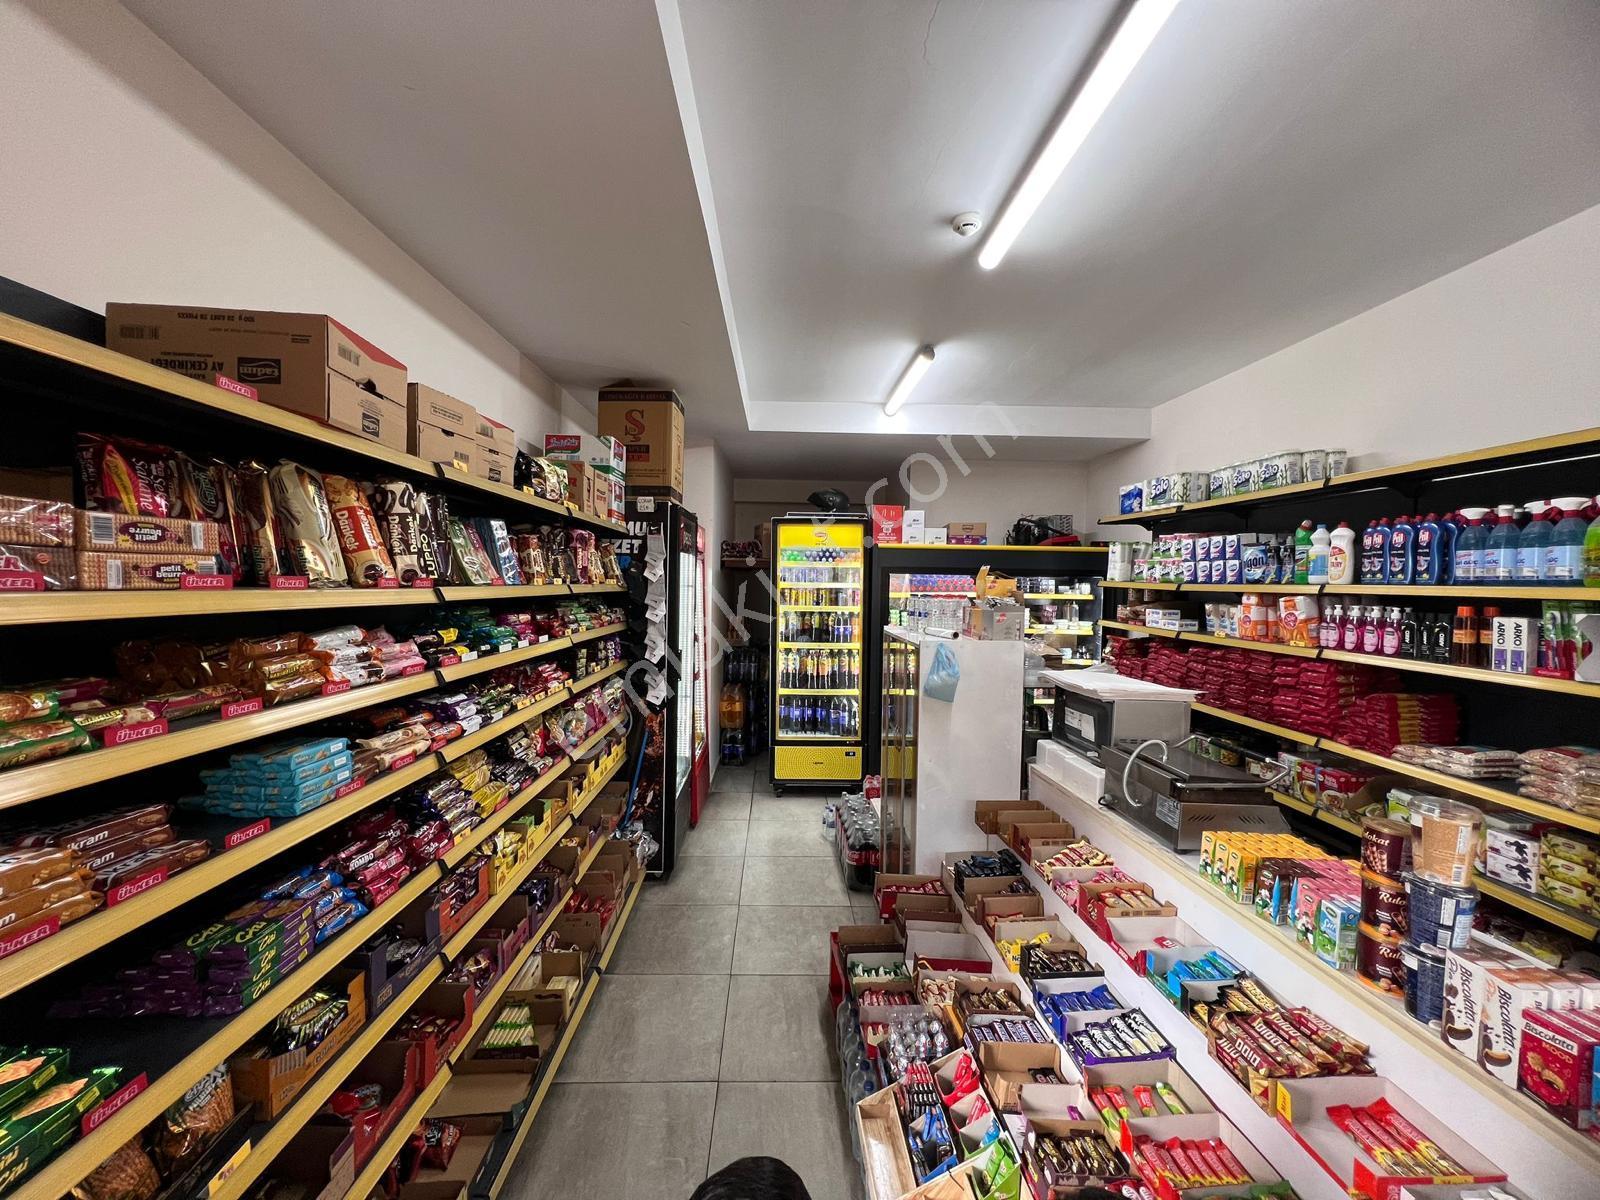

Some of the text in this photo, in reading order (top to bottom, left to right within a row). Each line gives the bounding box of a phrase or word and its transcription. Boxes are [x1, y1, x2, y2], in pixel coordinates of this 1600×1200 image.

[1151, 478, 1170, 498] Solo
[1393, 531, 1404, 544] Pril
[1418, 529, 1429, 543] Pril
[420, 533, 438, 579] LUPPO
[160, 564, 182, 573] petit
[185, 576, 225, 587] ÜLKER
[276, 578, 304, 588] ÜLKER
[1496, 621, 1505, 645] ARKO
[1513, 621, 1523, 647] ARKO
[327, 682, 350, 694] ÜLKER
[228, 702, 258, 717] ÜLKER
[116, 725, 163, 743] ÜLKER
[338, 780, 361, 797] ÜLKER
[230, 825, 264, 846] ÜLKER
[117, 873, 162, 901] ÜLKER
[1459, 963, 1477, 1024] Biscolata
[1497, 985, 1517, 1050] Biscolata
[1523, 1022, 1575, 1052] Biscolata
[1542, 1042, 1573, 1064] MOOD
[90, 1085, 138, 1128] ÜLKER
